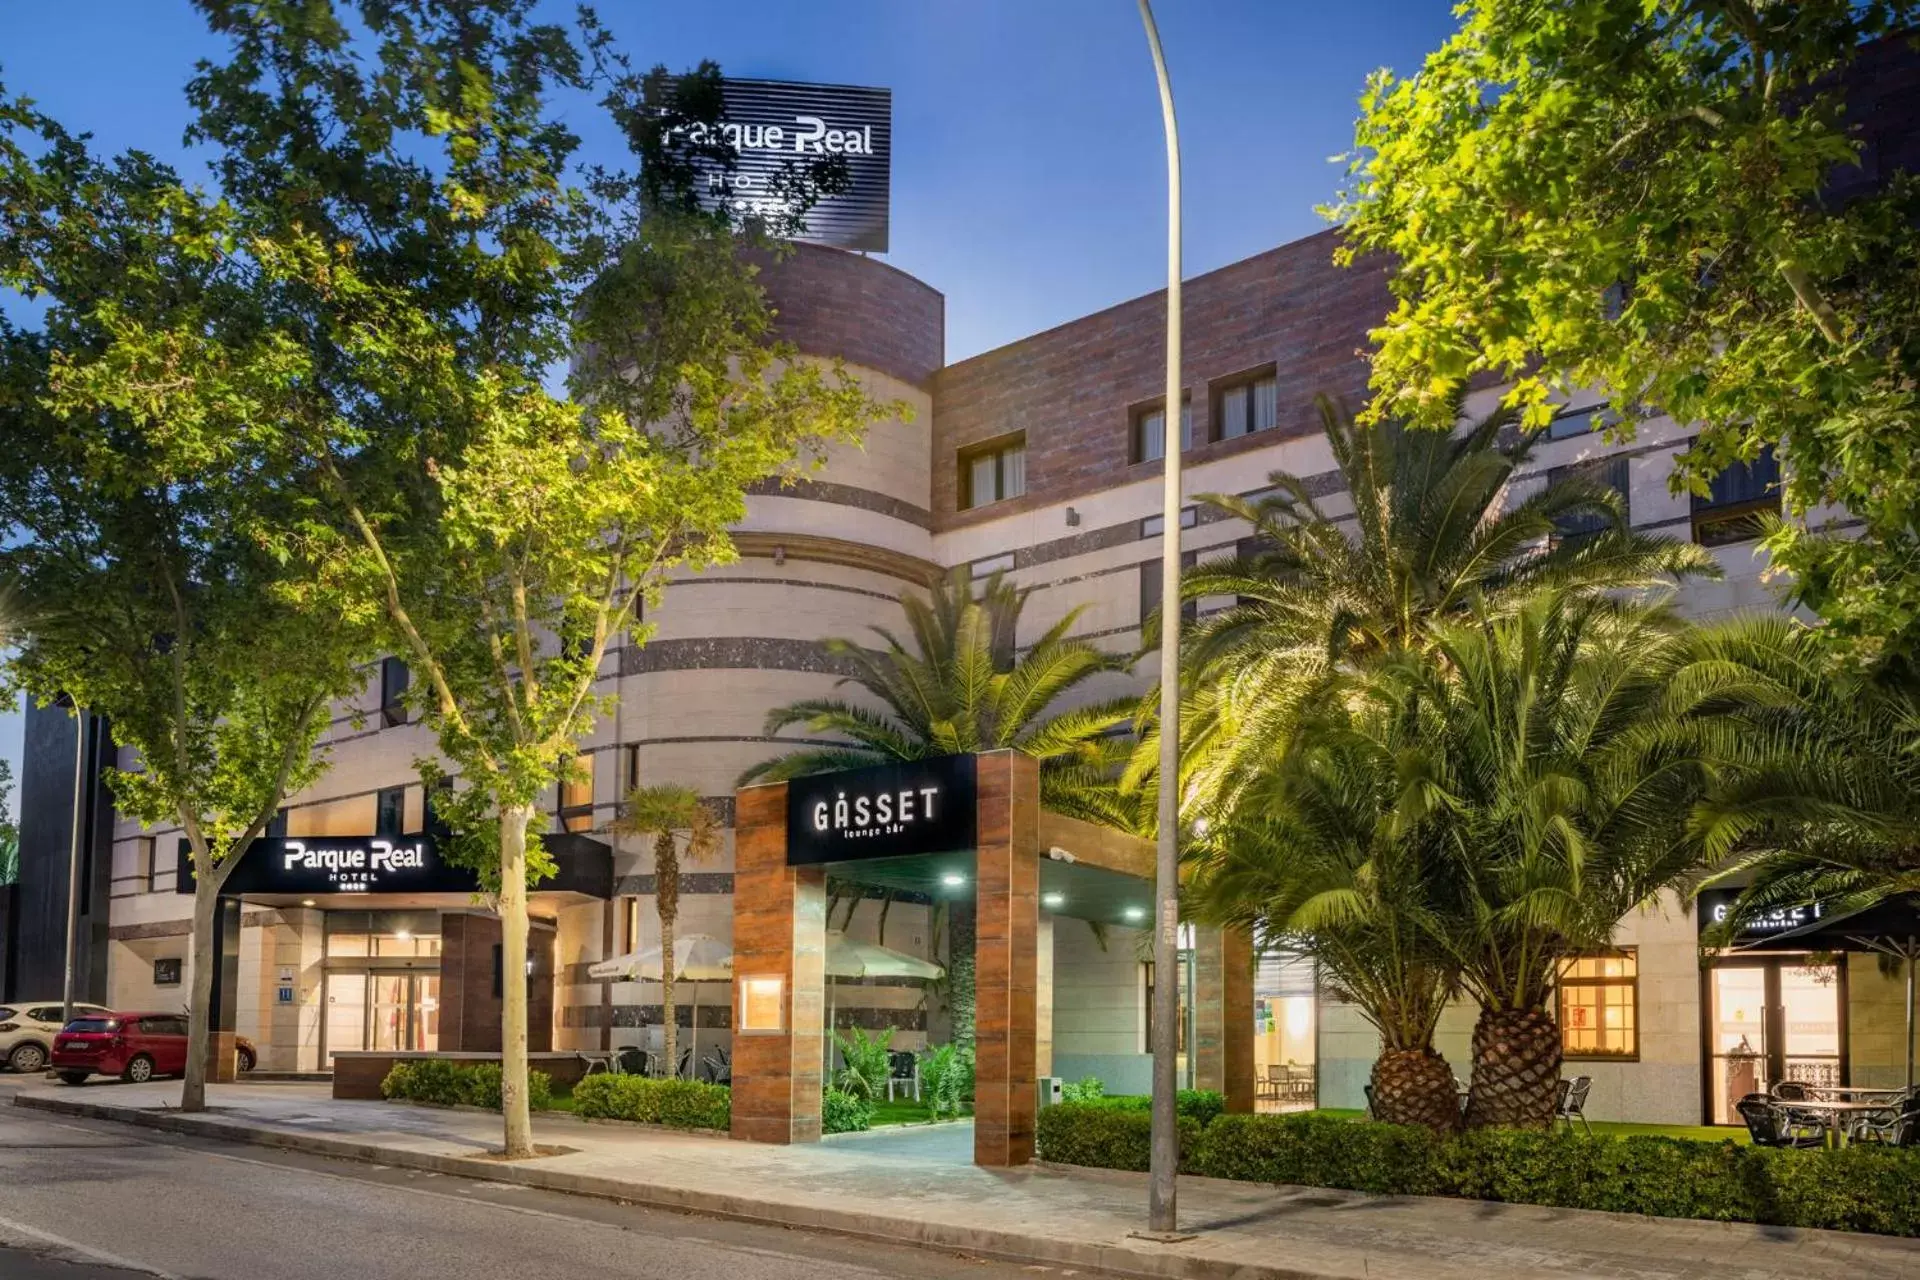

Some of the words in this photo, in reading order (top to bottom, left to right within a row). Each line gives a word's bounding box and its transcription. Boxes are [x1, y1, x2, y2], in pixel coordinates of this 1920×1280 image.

[795, 116, 874, 155] Real
[284, 841, 366, 873] Parque
[370, 840, 424, 872] Real
[328, 873, 379, 882] HOTEL
